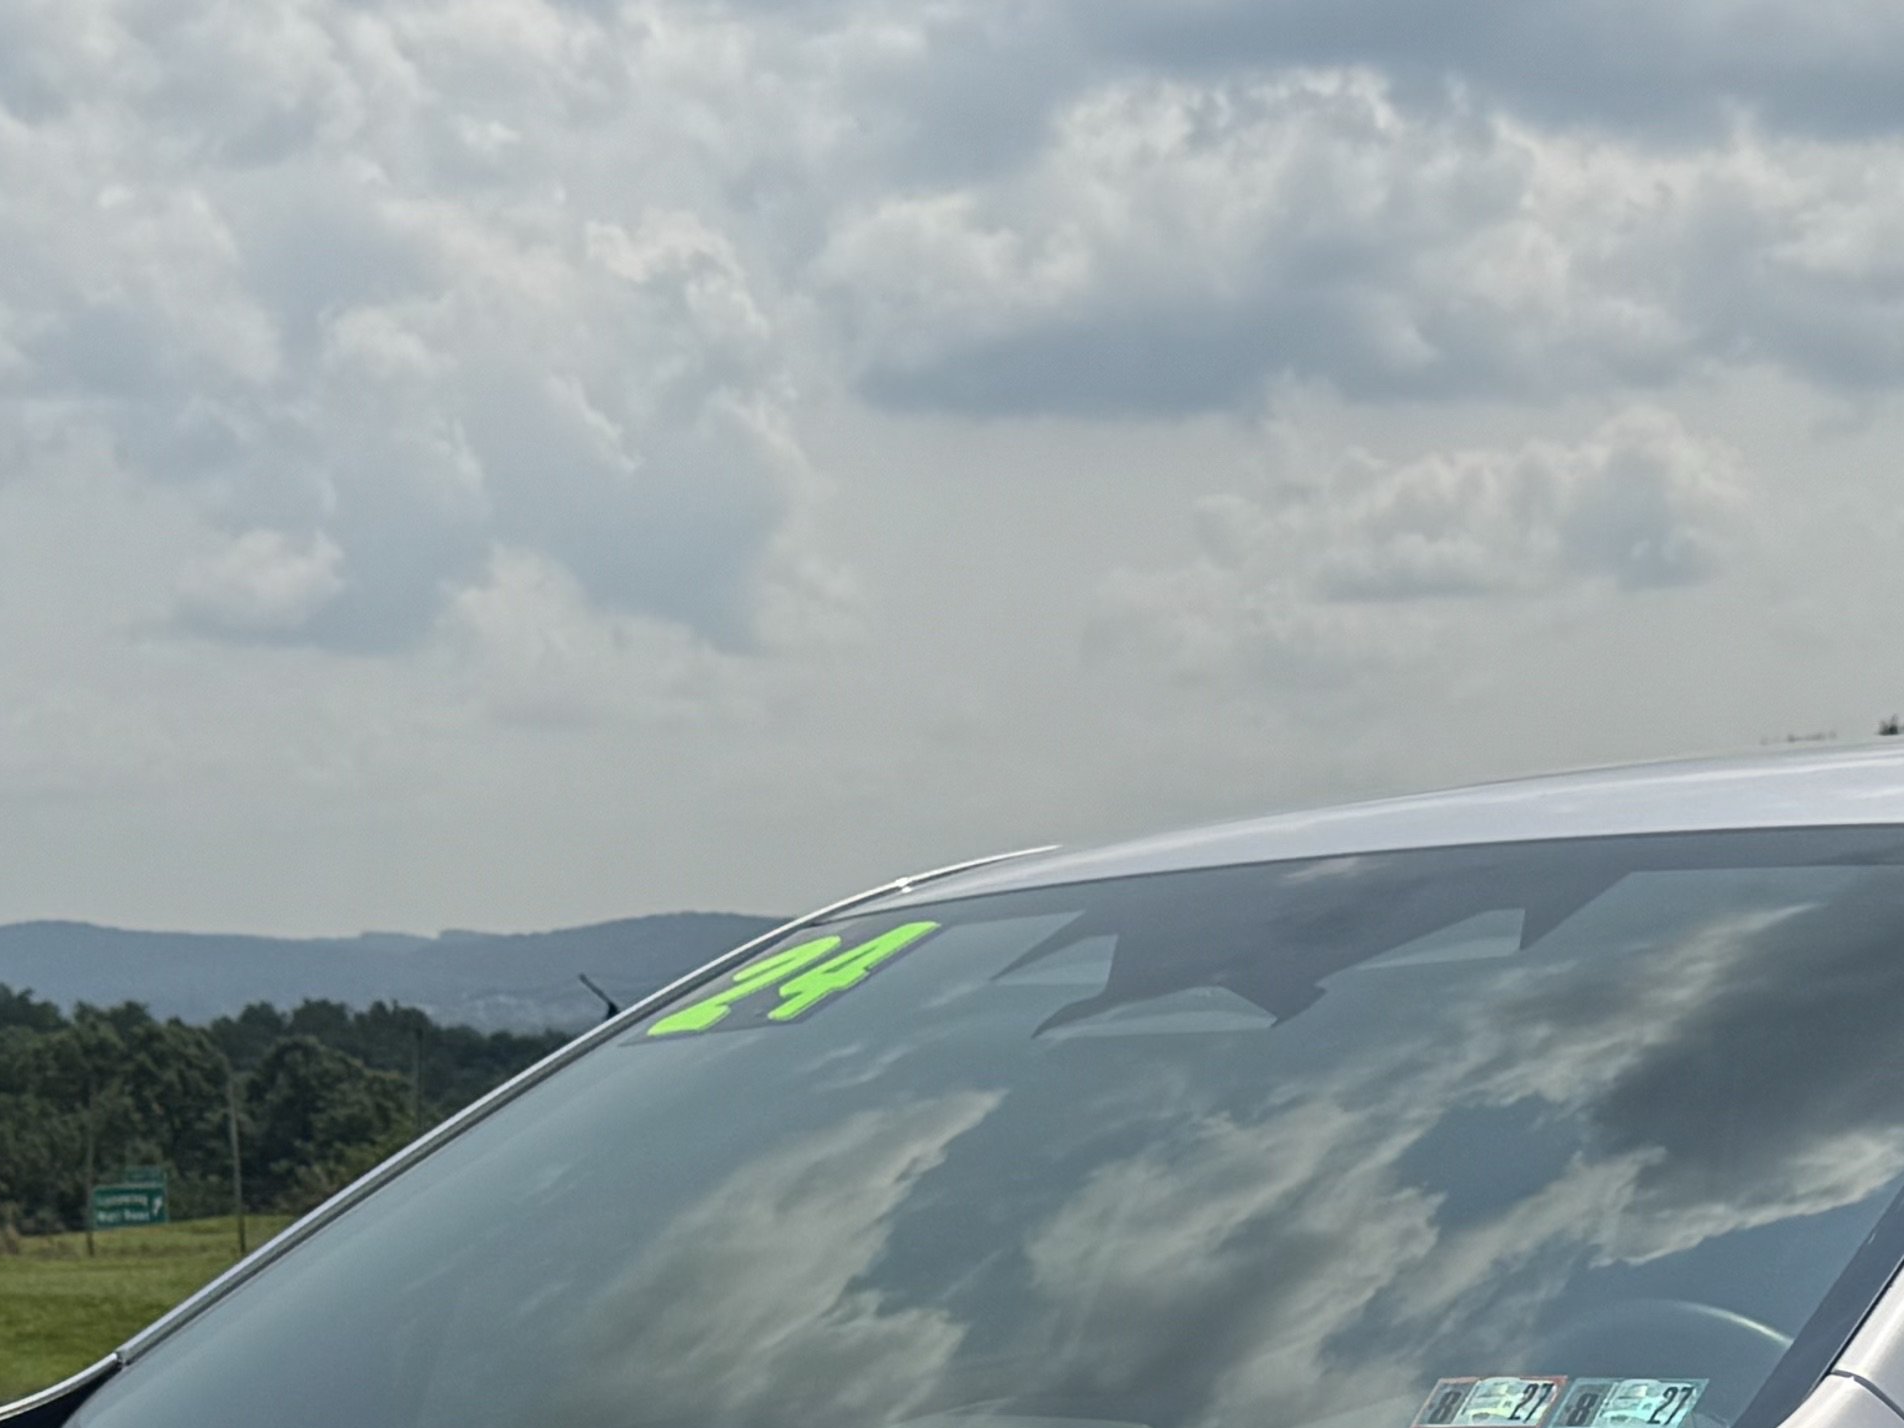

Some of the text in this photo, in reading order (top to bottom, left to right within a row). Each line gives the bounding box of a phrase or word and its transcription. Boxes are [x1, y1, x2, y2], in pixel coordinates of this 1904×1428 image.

[647, 921, 941, 1036] 24
[1508, 1383, 1554, 1423] 27
[1646, 1386, 1695, 1426] 27
